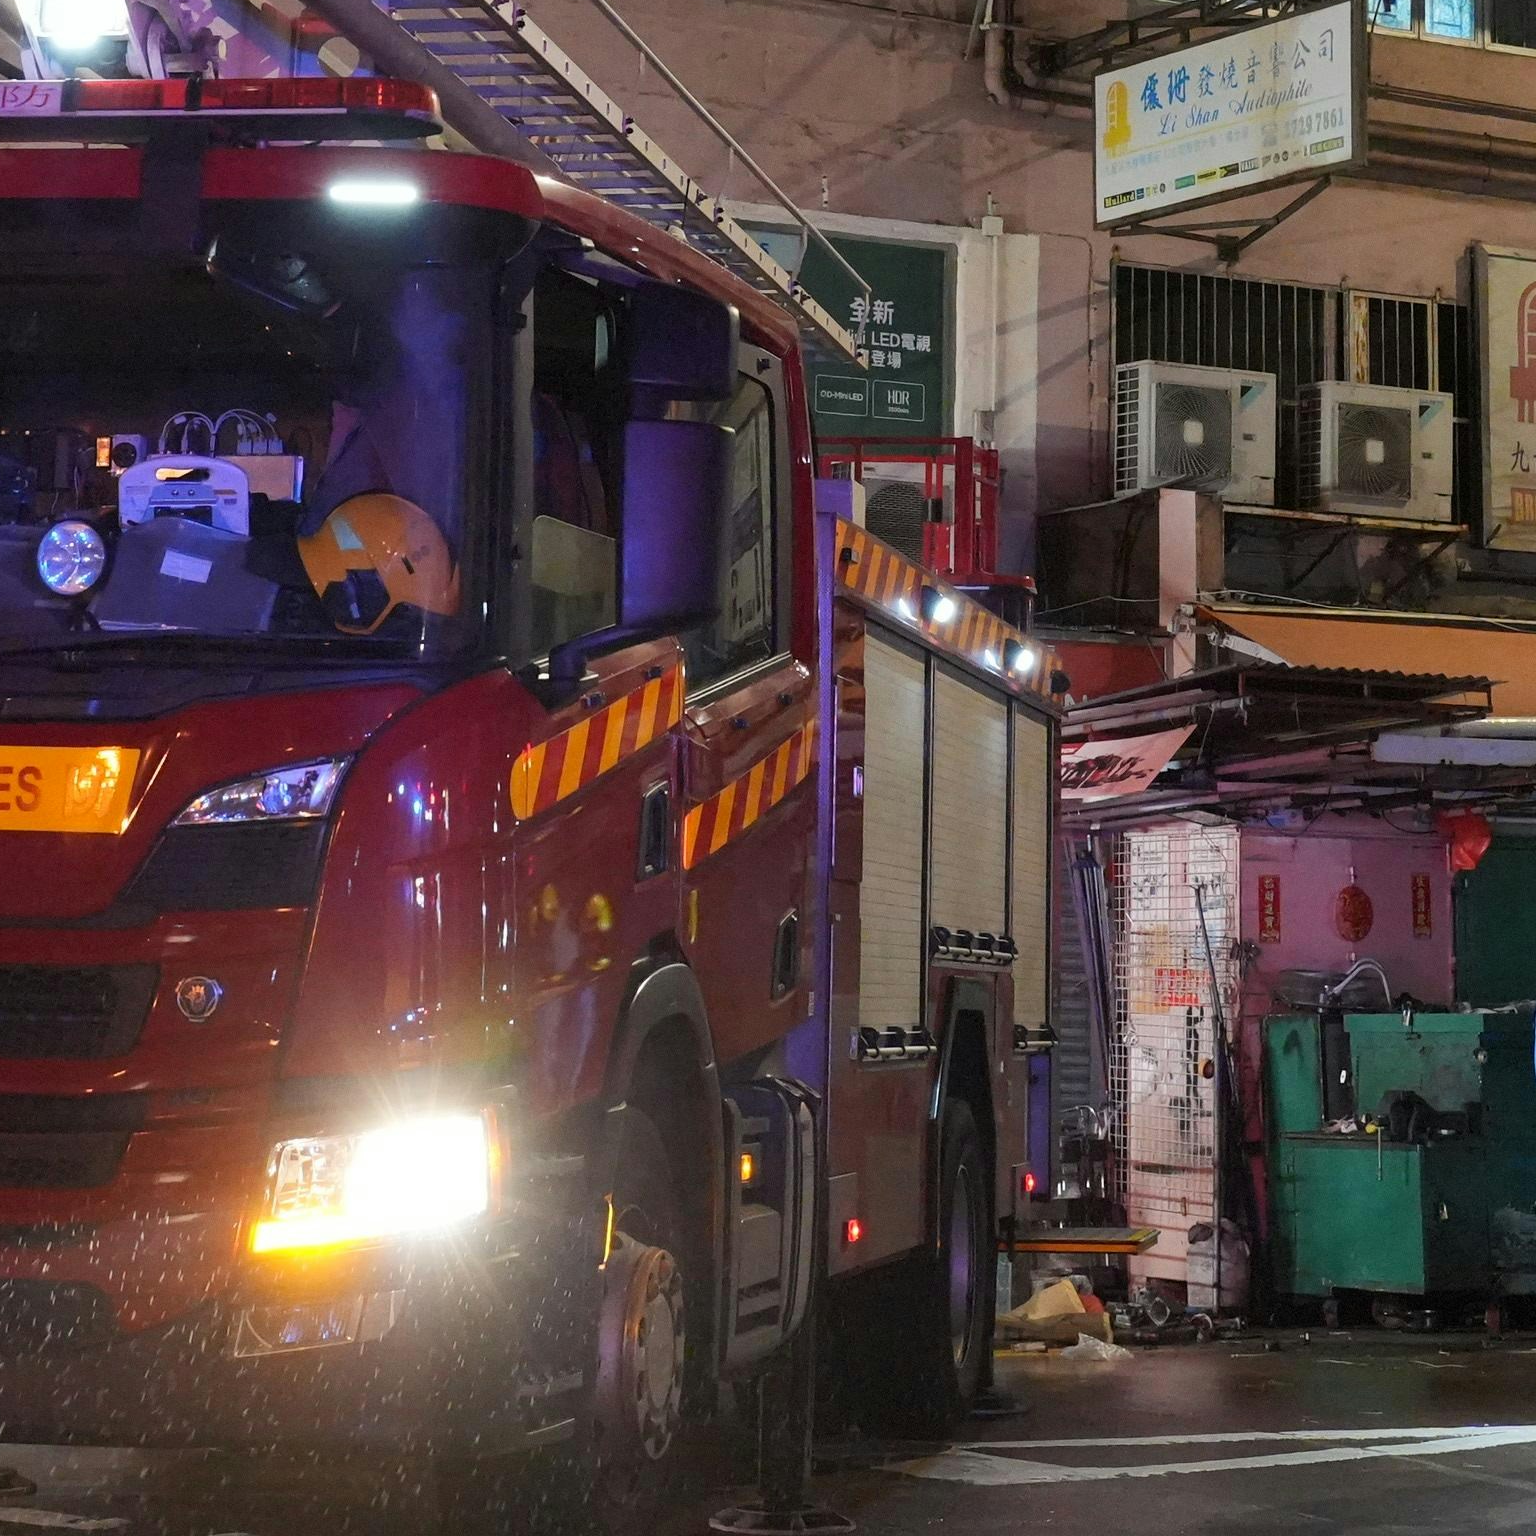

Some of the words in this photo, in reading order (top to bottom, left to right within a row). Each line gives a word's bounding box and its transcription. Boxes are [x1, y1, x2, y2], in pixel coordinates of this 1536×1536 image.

[1185, 104, 1220, 129] Shan
[849, 296, 894, 326] 全新
[887, 389, 910, 405] HDR
